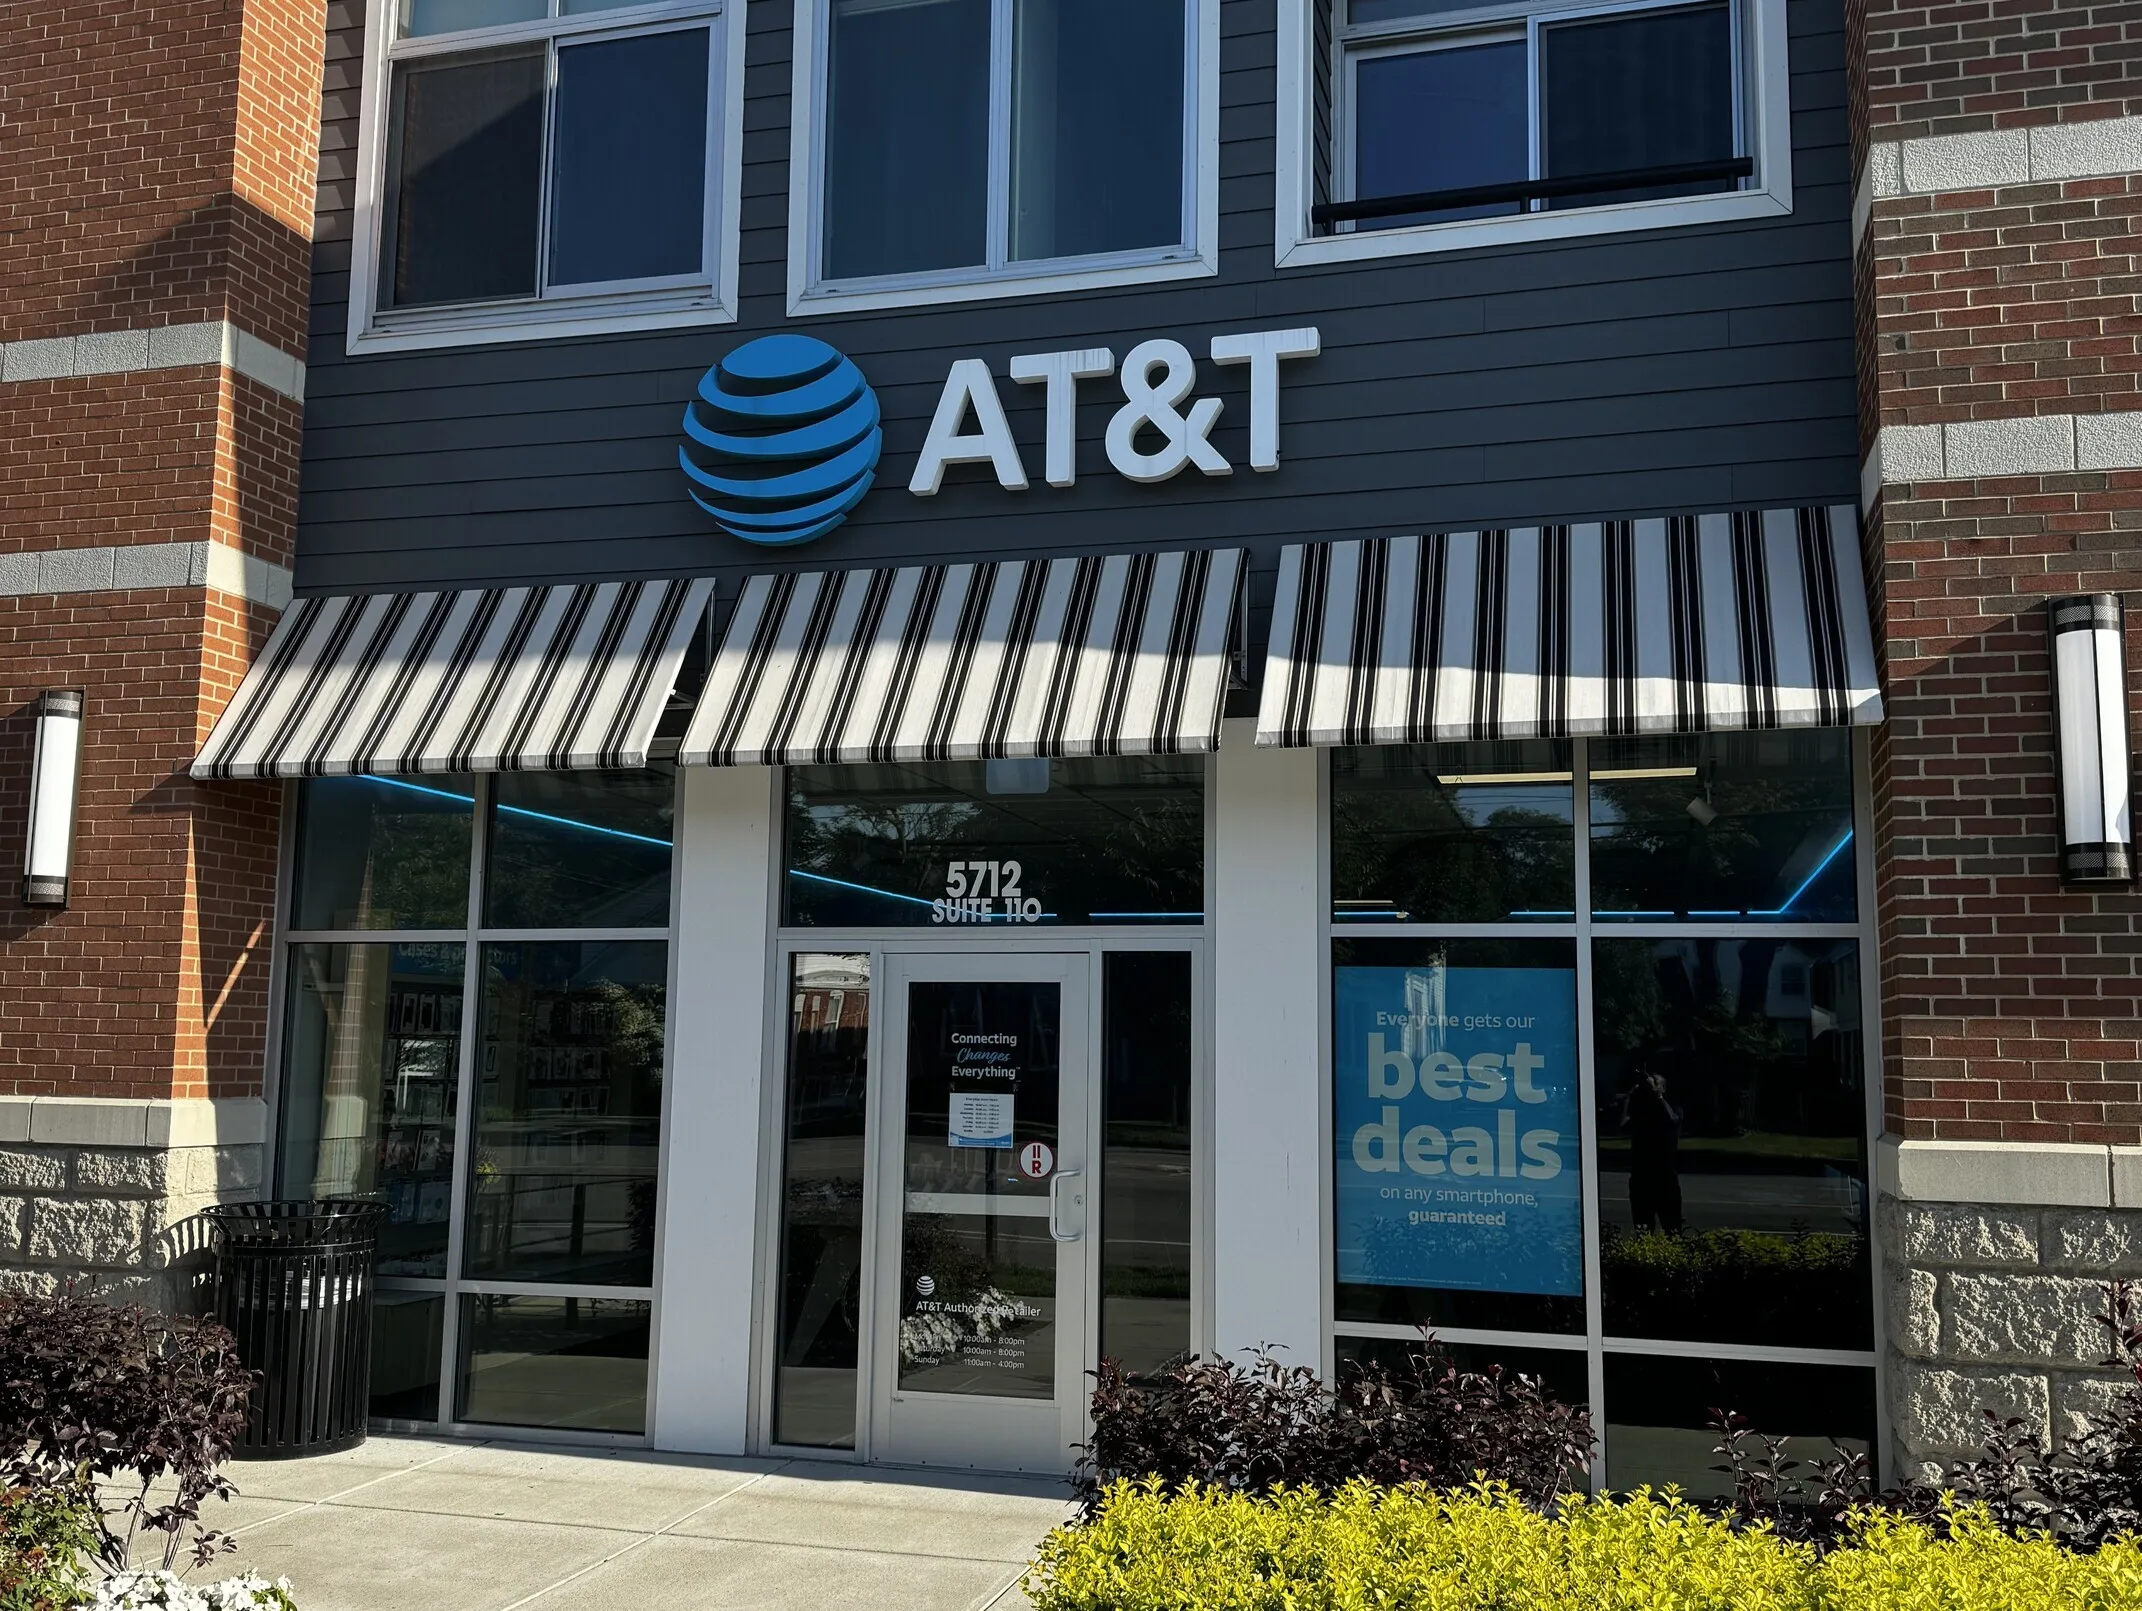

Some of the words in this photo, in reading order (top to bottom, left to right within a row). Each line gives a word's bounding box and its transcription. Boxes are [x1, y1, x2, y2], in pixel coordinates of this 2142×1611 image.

[908, 327, 1321, 496] AT&T
[946, 860, 1022, 898] 5712
[932, 898, 992, 923] SUITE
[1004, 897, 1042, 923] 110
[1376, 1011, 1460, 1028] Everyone
[1463, 1014, 1502, 1031] gets
[1507, 1015, 1536, 1029] our
[951, 1033, 1018, 1047] Connecting
[956, 1048, 1011, 1064] Changes
[1367, 1032, 1547, 1104] best
[1352, 1106, 1562, 1180] deals
[1380, 1186, 1400, 1200] on
[1404, 1187, 1432, 1205] any
[1436, 1188, 1539, 1207] smartphone,
[1408, 1209, 1507, 1227] guaranteed
[916, 1301, 942, 1311] AT&T
[944, 1302, 999, 1315] Authorzed
[998, 1337, 1025, 1346] 8:00pm
[963, 1346, 992, 1355] 10:00am
[998, 1348, 1025, 1357] 8:00pm
[914, 1355, 940, 1366] Sunday
[963, 1358, 992, 1367] 11:00am
[998, 1359, 1025, 1369] 4:00pm
